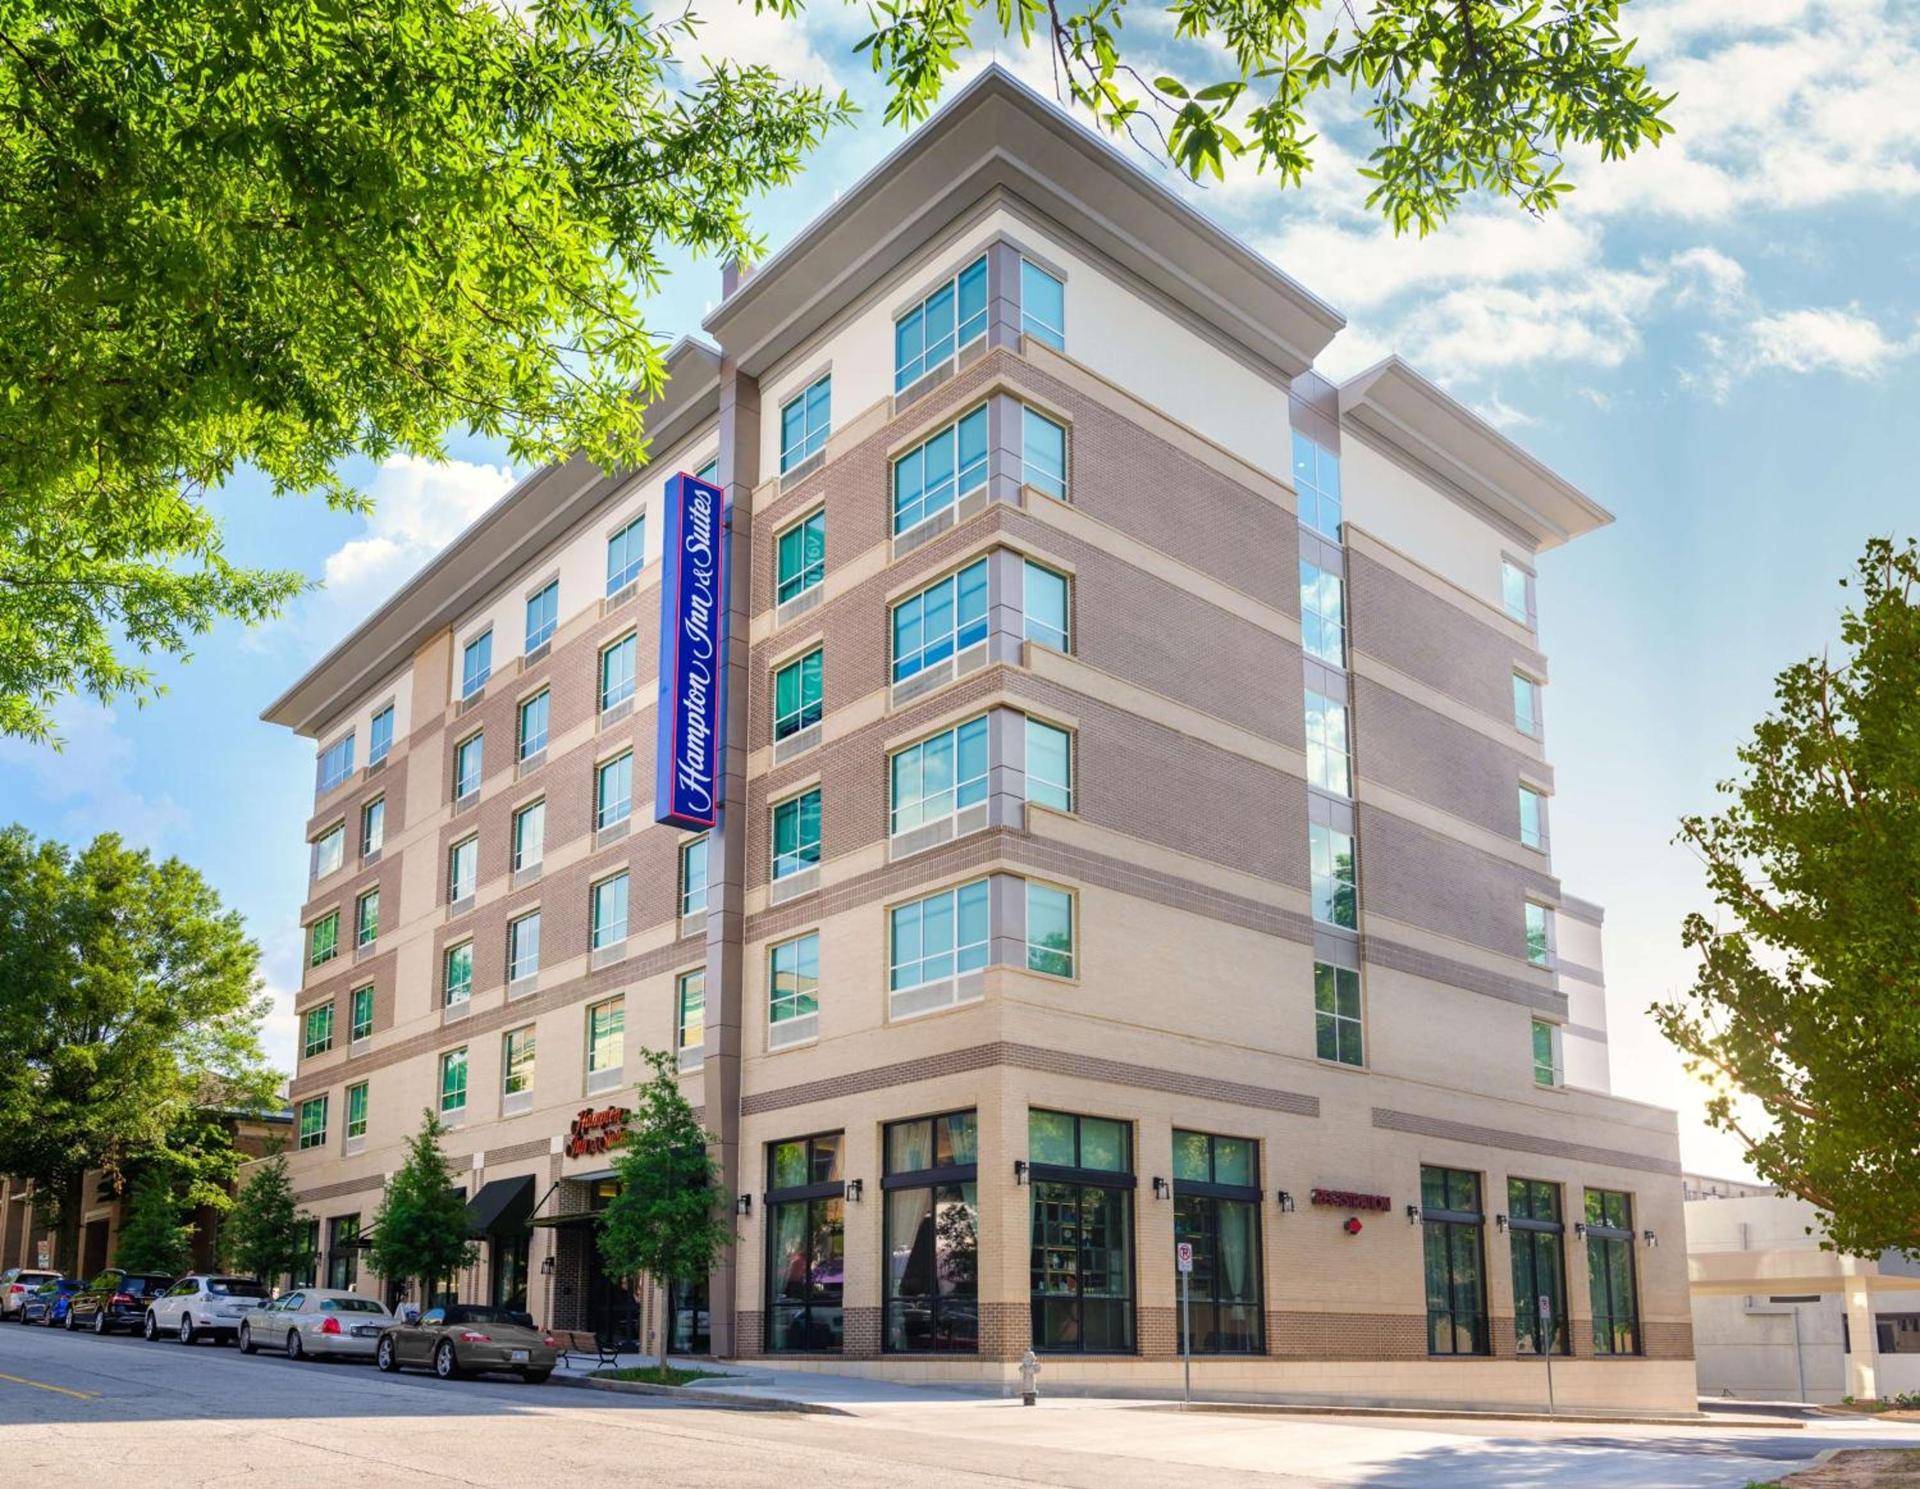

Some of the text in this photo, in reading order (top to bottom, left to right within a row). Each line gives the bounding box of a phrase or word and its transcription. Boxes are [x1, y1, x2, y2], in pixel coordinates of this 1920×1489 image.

[677, 489, 714, 812] Hampton Inn & Suites
